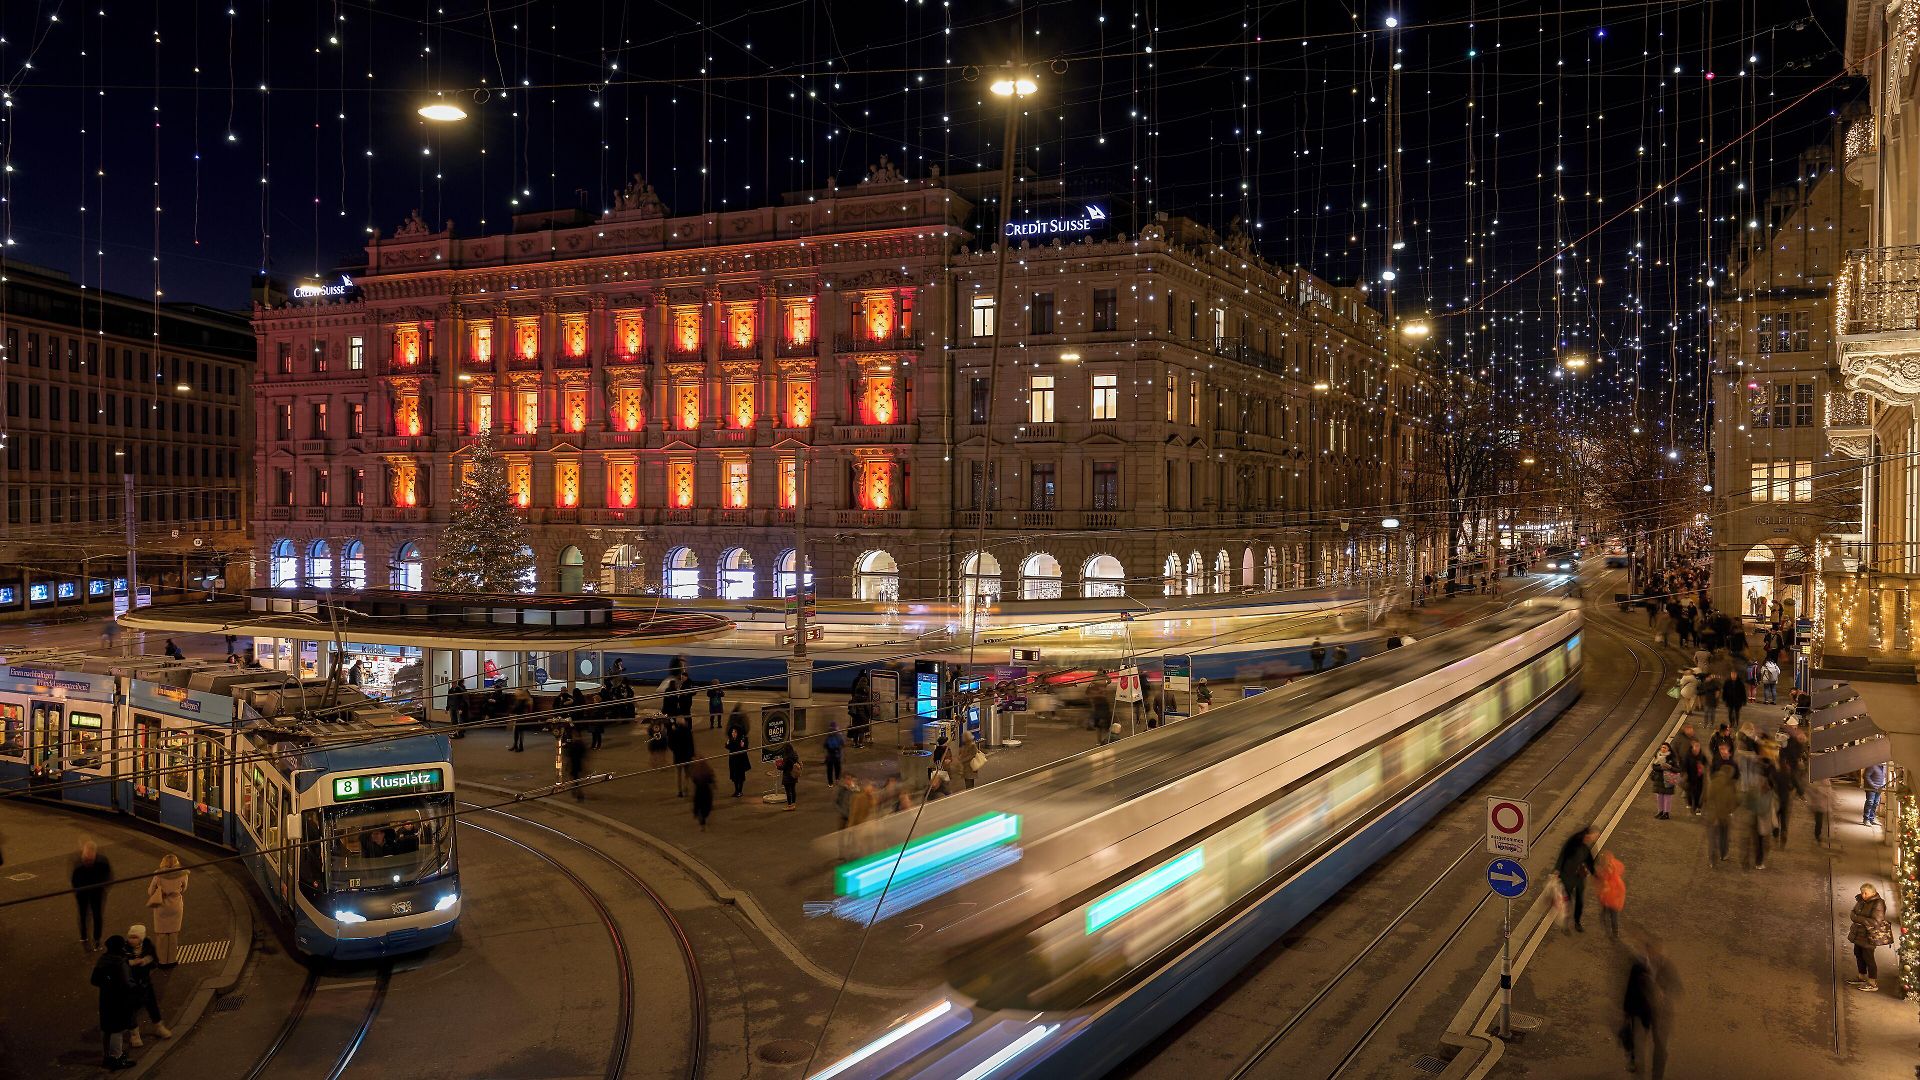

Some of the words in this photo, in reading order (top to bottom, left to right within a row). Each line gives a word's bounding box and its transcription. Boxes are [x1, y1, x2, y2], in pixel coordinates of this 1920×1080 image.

[1050, 219, 1090, 232] SUISSE
[343, 780, 353, 793] 8
[371, 773, 430, 789] Klusplatz
